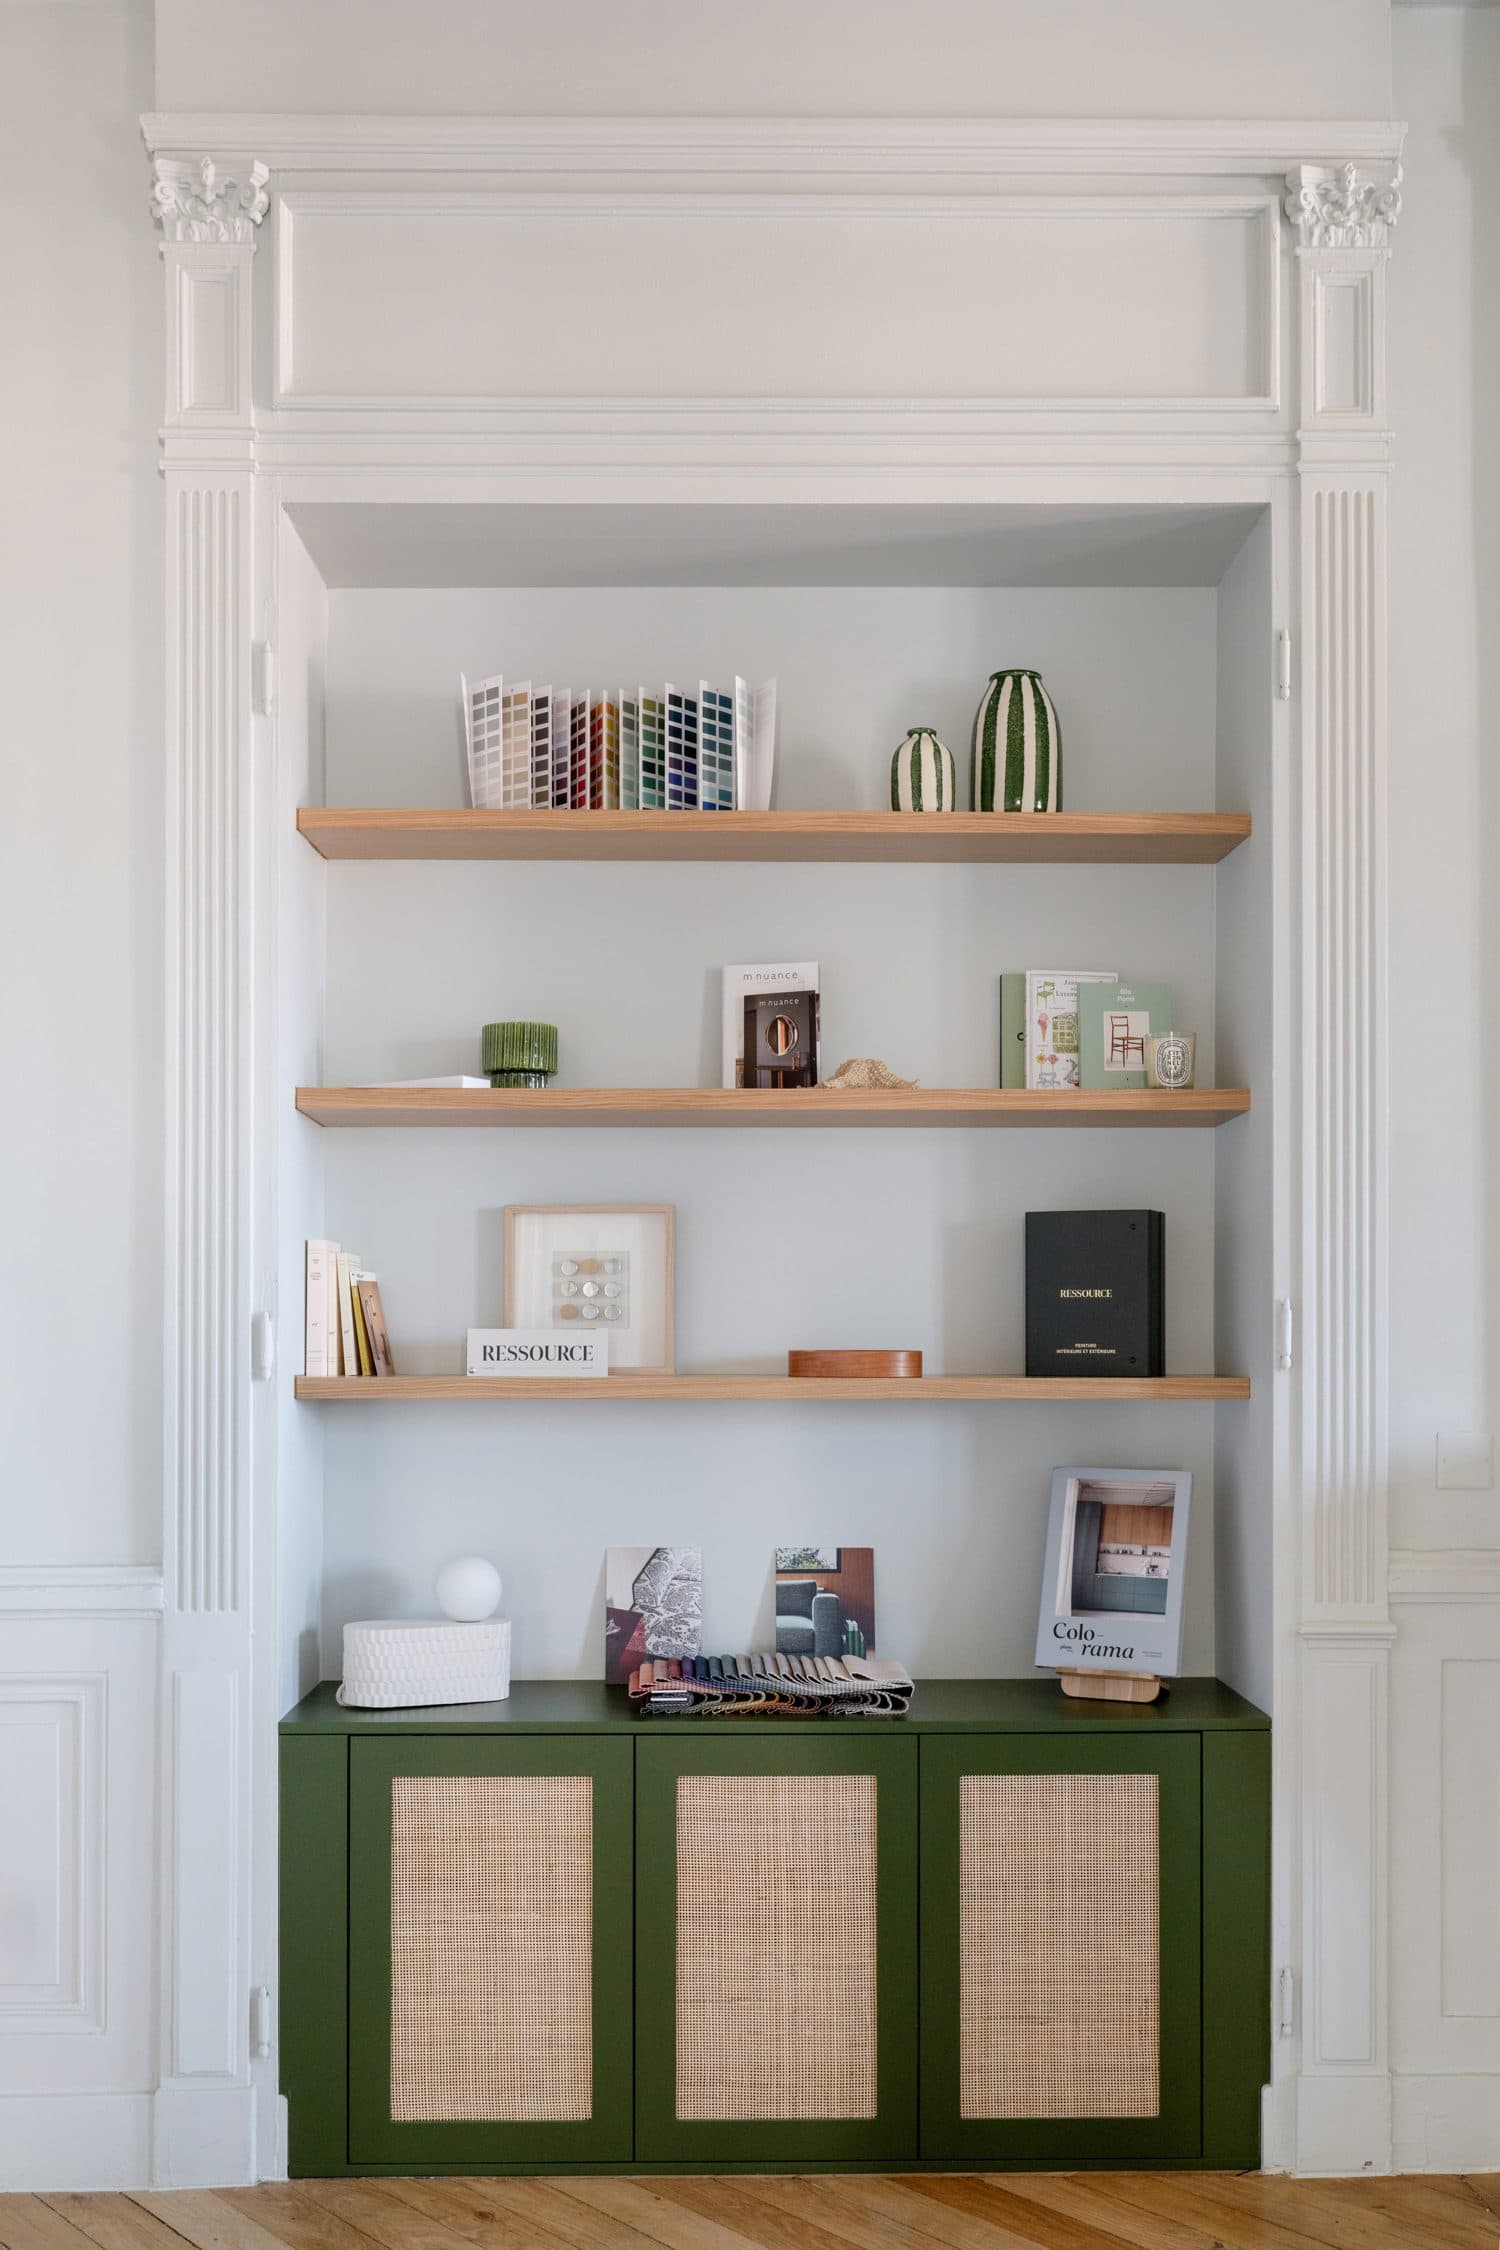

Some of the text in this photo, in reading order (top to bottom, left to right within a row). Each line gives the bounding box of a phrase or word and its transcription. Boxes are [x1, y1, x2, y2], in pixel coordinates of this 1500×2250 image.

[1060, 1288, 1113, 1298] RESSOURCE
[482, 1345, 594, 1361] RESSOURCE
[1081, 1643, 1134, 1659] rama
